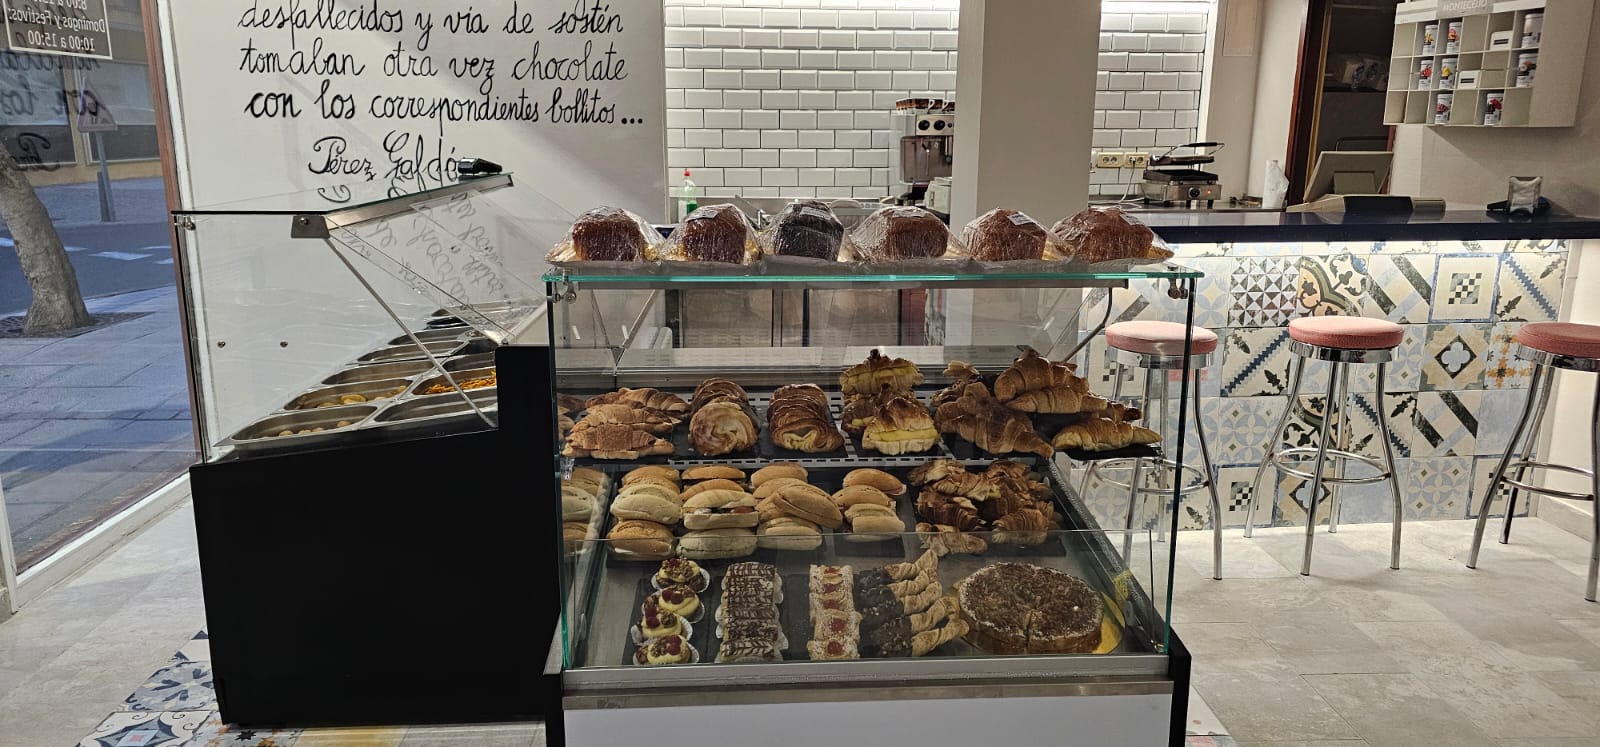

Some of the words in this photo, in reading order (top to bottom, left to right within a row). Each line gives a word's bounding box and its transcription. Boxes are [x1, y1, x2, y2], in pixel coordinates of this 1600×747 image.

[238, 0, 402, 50] desfallecidos
[415, 12, 432, 51] y
[503, 1, 534, 33] de
[548, 0, 623, 33] sostén
[384, 41, 438, 76] otra
[450, 57, 495, 95] vez
[511, 40, 628, 81] chocolate
[244, 92, 302, 118] con
[314, 79, 355, 119] los
[369, 88, 539, 135] correspondientes
[308, 136, 376, 182] Pérez
[384, 130, 459, 184] Galdó
